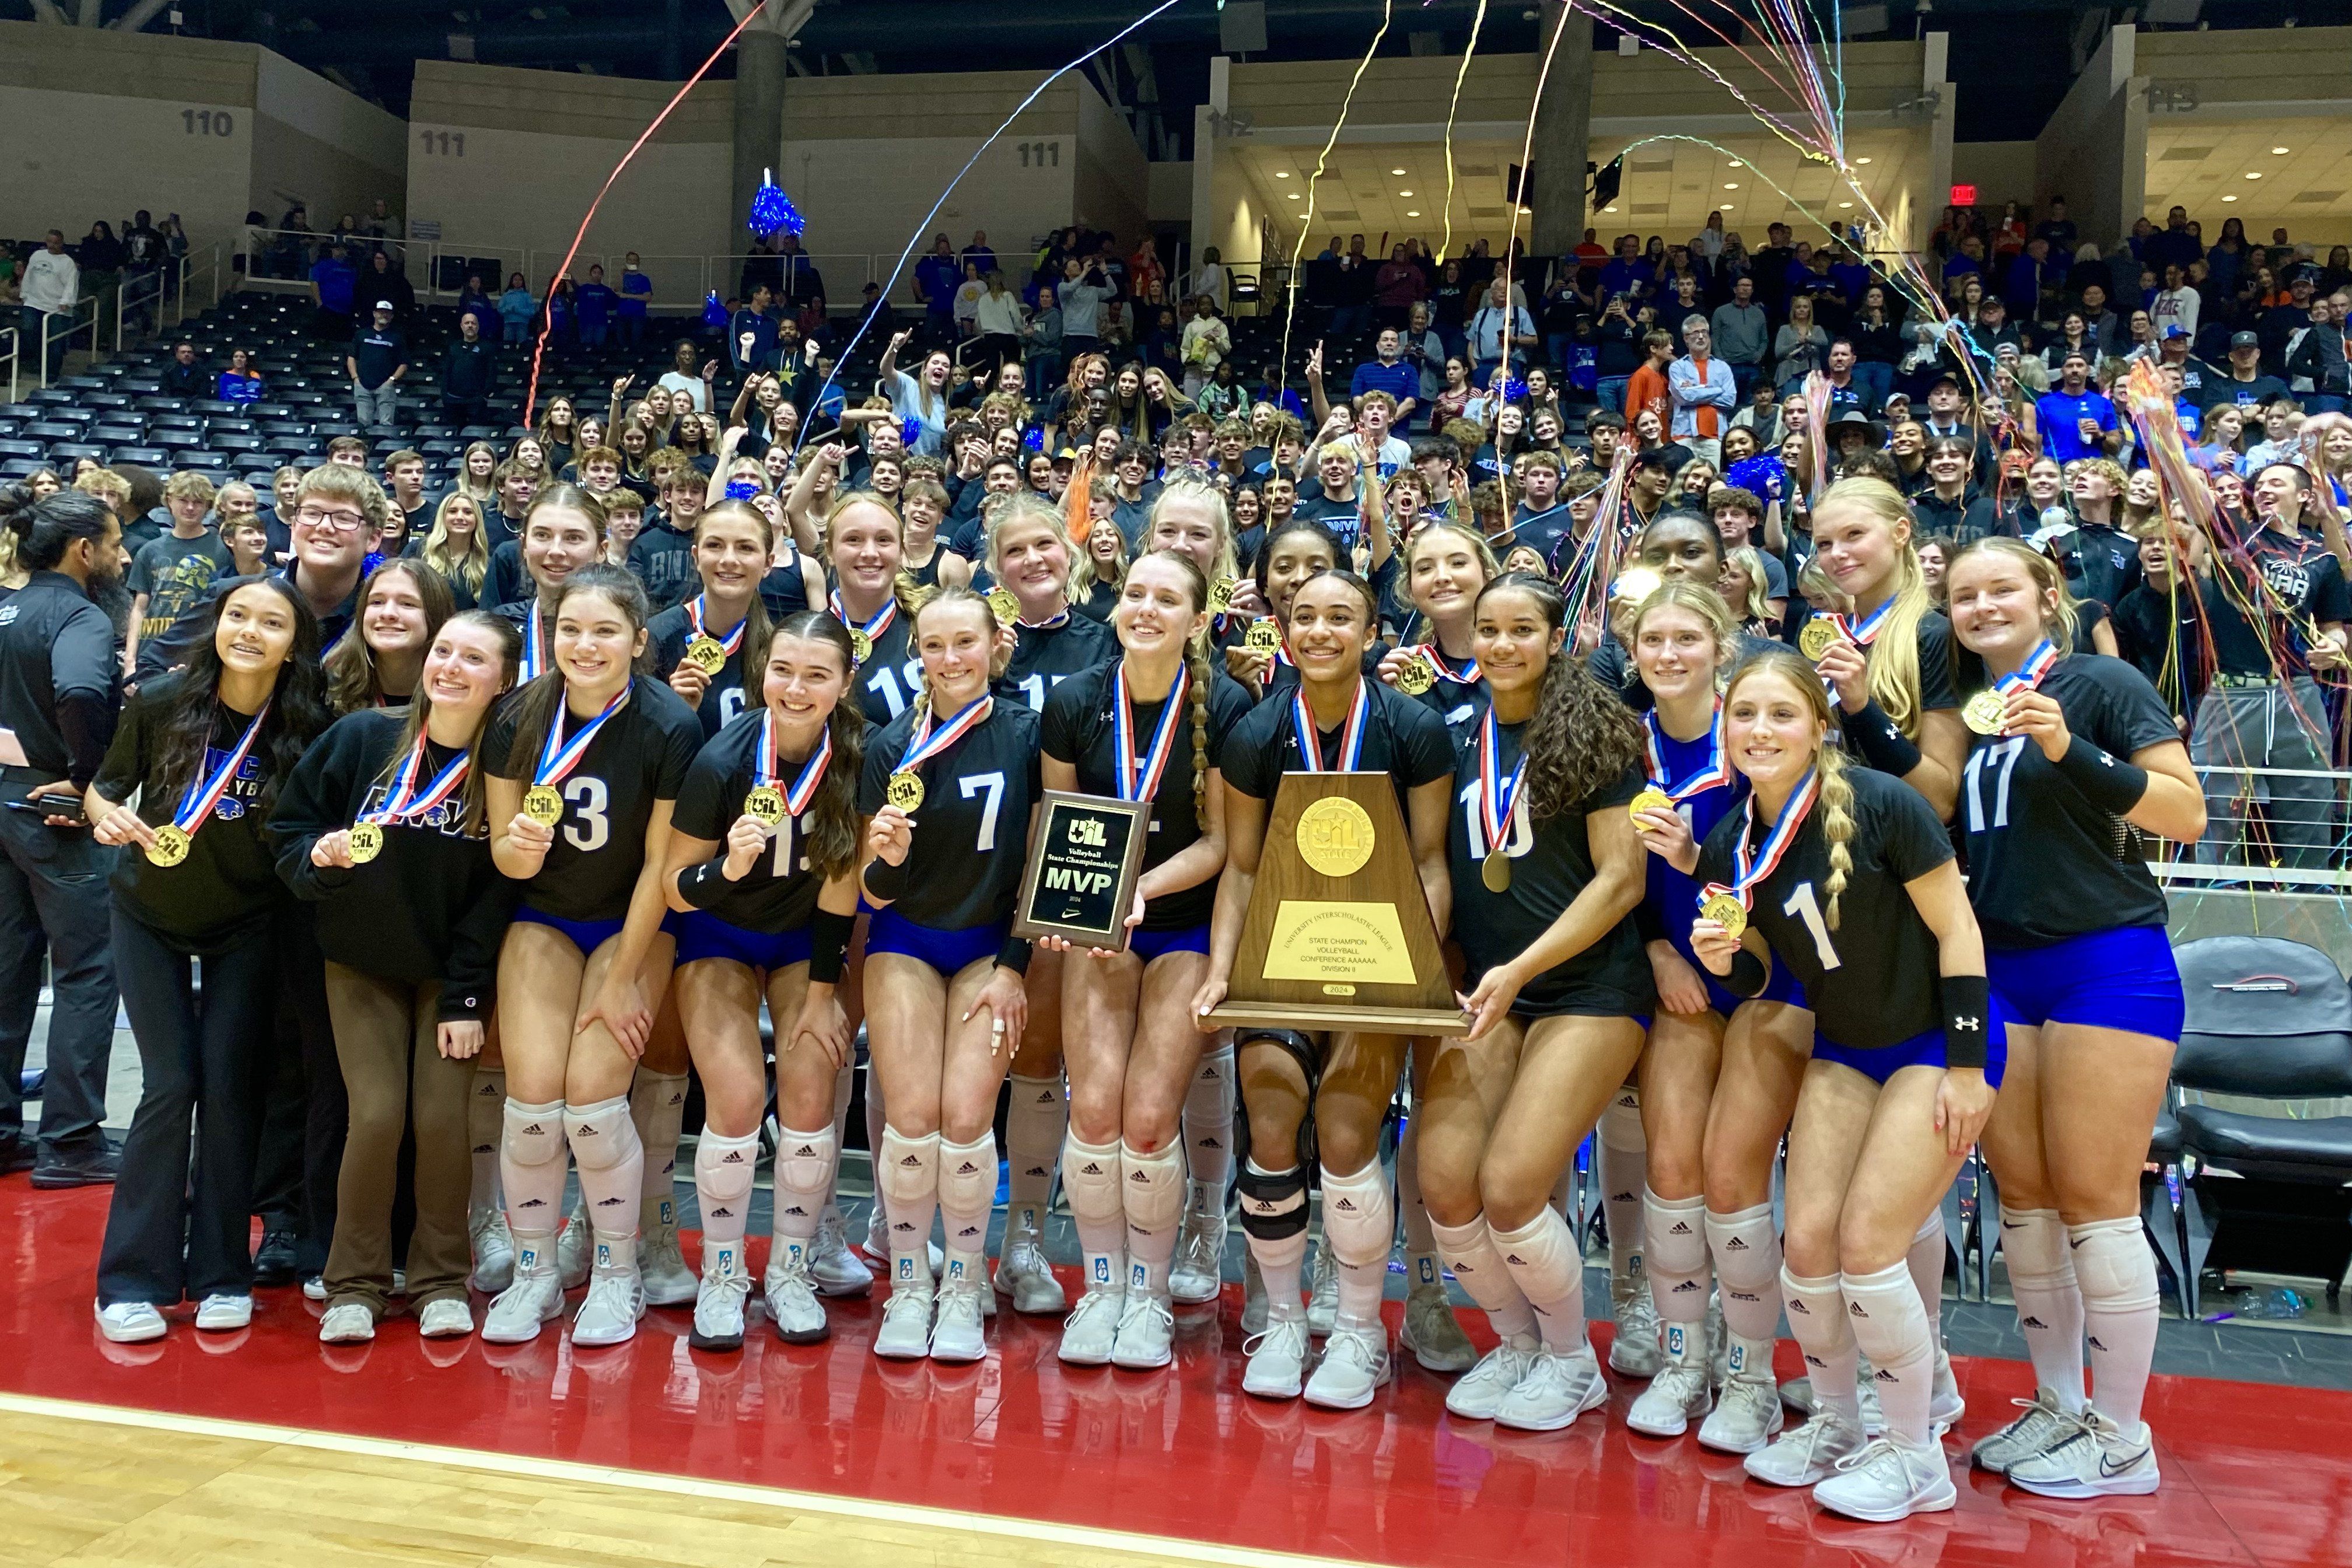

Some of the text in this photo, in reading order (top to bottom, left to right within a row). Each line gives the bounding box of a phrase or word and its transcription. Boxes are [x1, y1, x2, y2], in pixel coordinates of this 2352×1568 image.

[181, 109, 233, 136] 110
[420, 130, 465, 157] 111
[1017, 142, 1059, 167] 111
[1964, 736, 2026, 832] 17
[563, 776, 608, 852] 3
[958, 771, 1005, 851] 7
[1048, 853, 1119, 870] State Championships
[1069, 848, 1101, 858] Volleyball
[1045, 867, 1112, 895] MVP
[1283, 911, 1393, 952] UNIVERSITY INTERSCHOLASTIC LEAGUE
[1782, 881, 1842, 970] 1
[1330, 937, 1367, 946] CHAMPION
